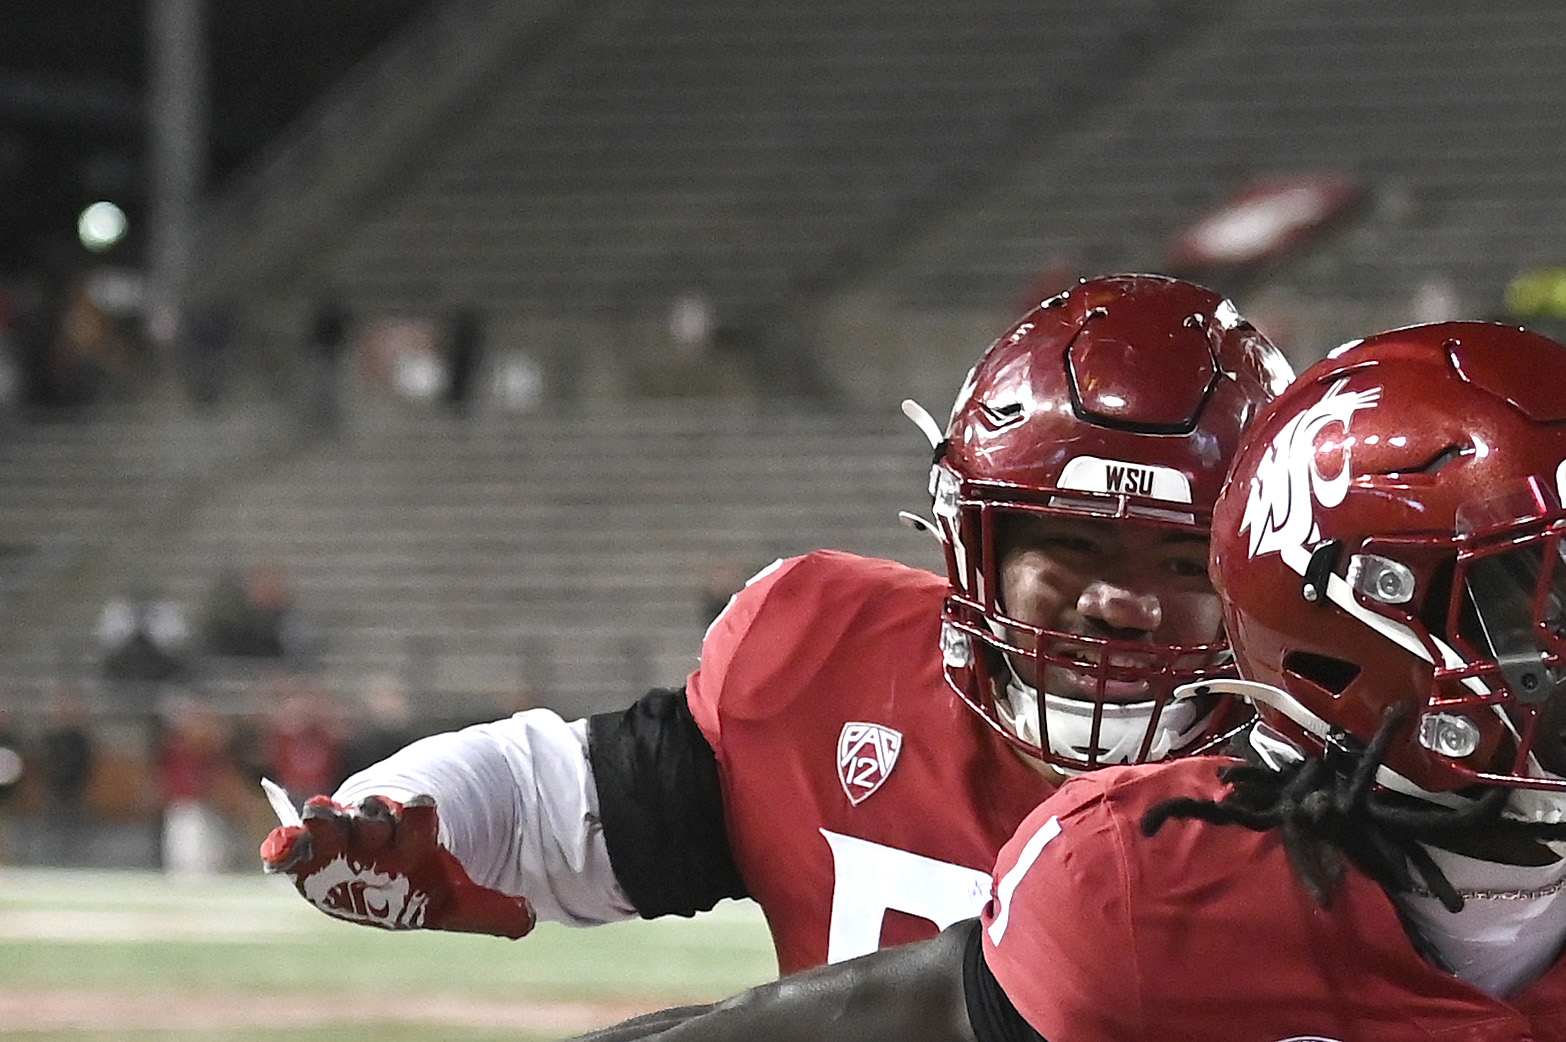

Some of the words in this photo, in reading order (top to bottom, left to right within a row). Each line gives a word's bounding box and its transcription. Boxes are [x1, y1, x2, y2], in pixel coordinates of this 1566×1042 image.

[1106, 465, 1154, 495] WSU
[841, 725, 898, 777] PAC
[846, 756, 879, 788] 12
